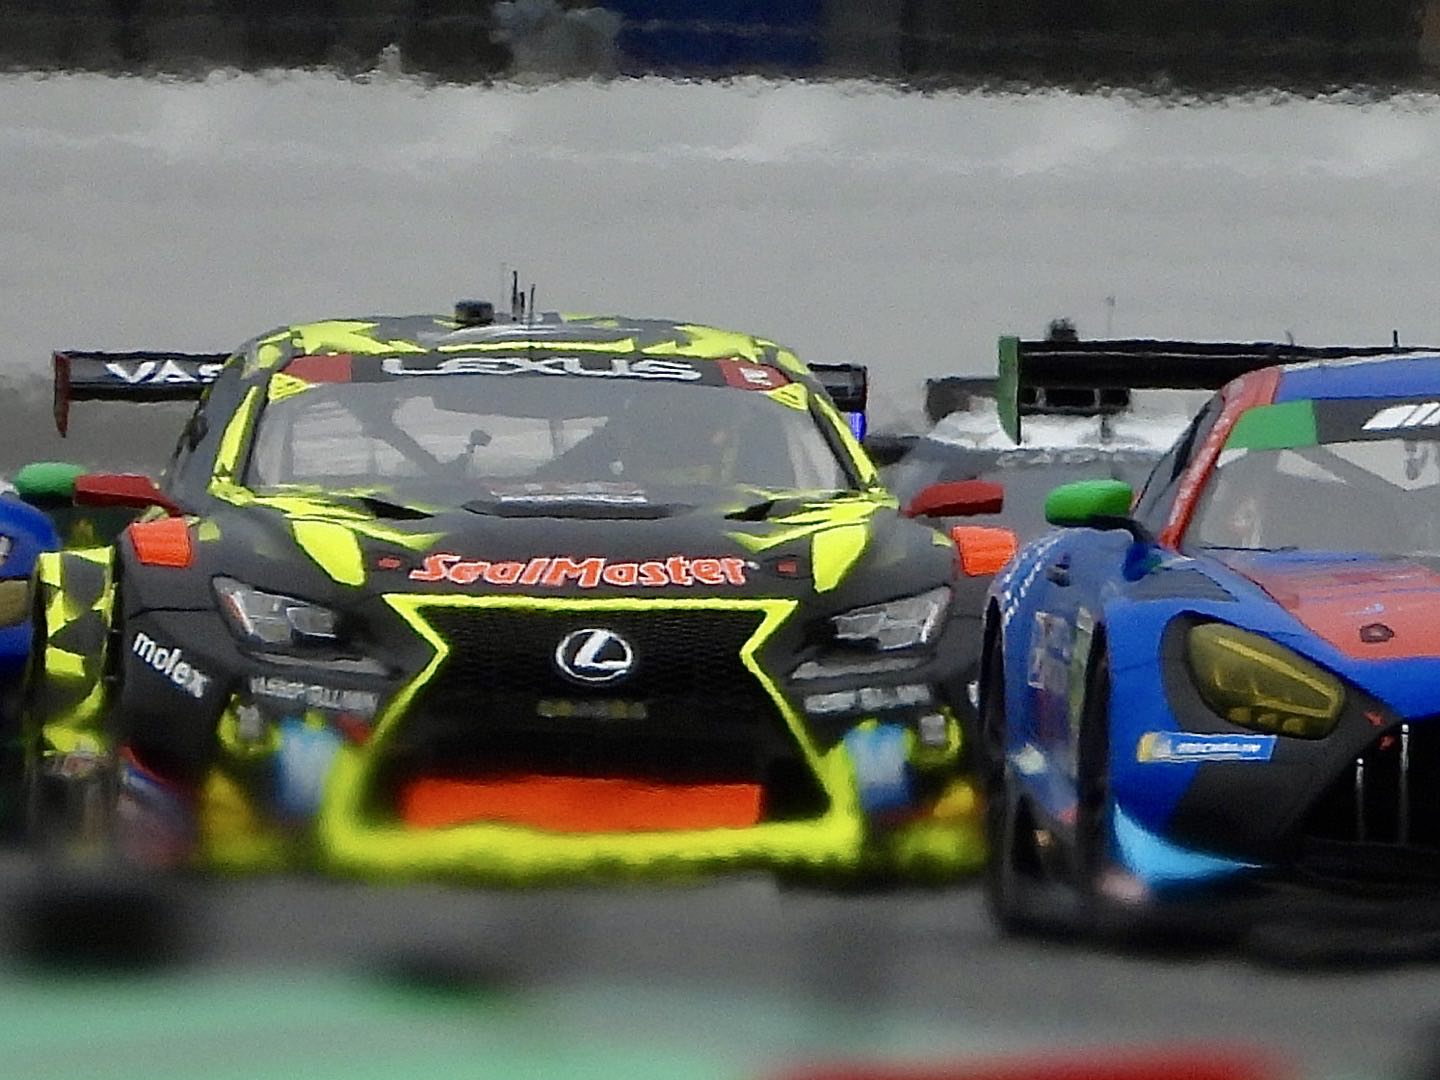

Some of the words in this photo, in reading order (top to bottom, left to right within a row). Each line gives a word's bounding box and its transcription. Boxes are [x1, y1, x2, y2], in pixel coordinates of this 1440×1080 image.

[382, 357, 701, 379] LEXUS
[409, 554, 747, 588] SealMaster
[132, 632, 210, 698] molex
